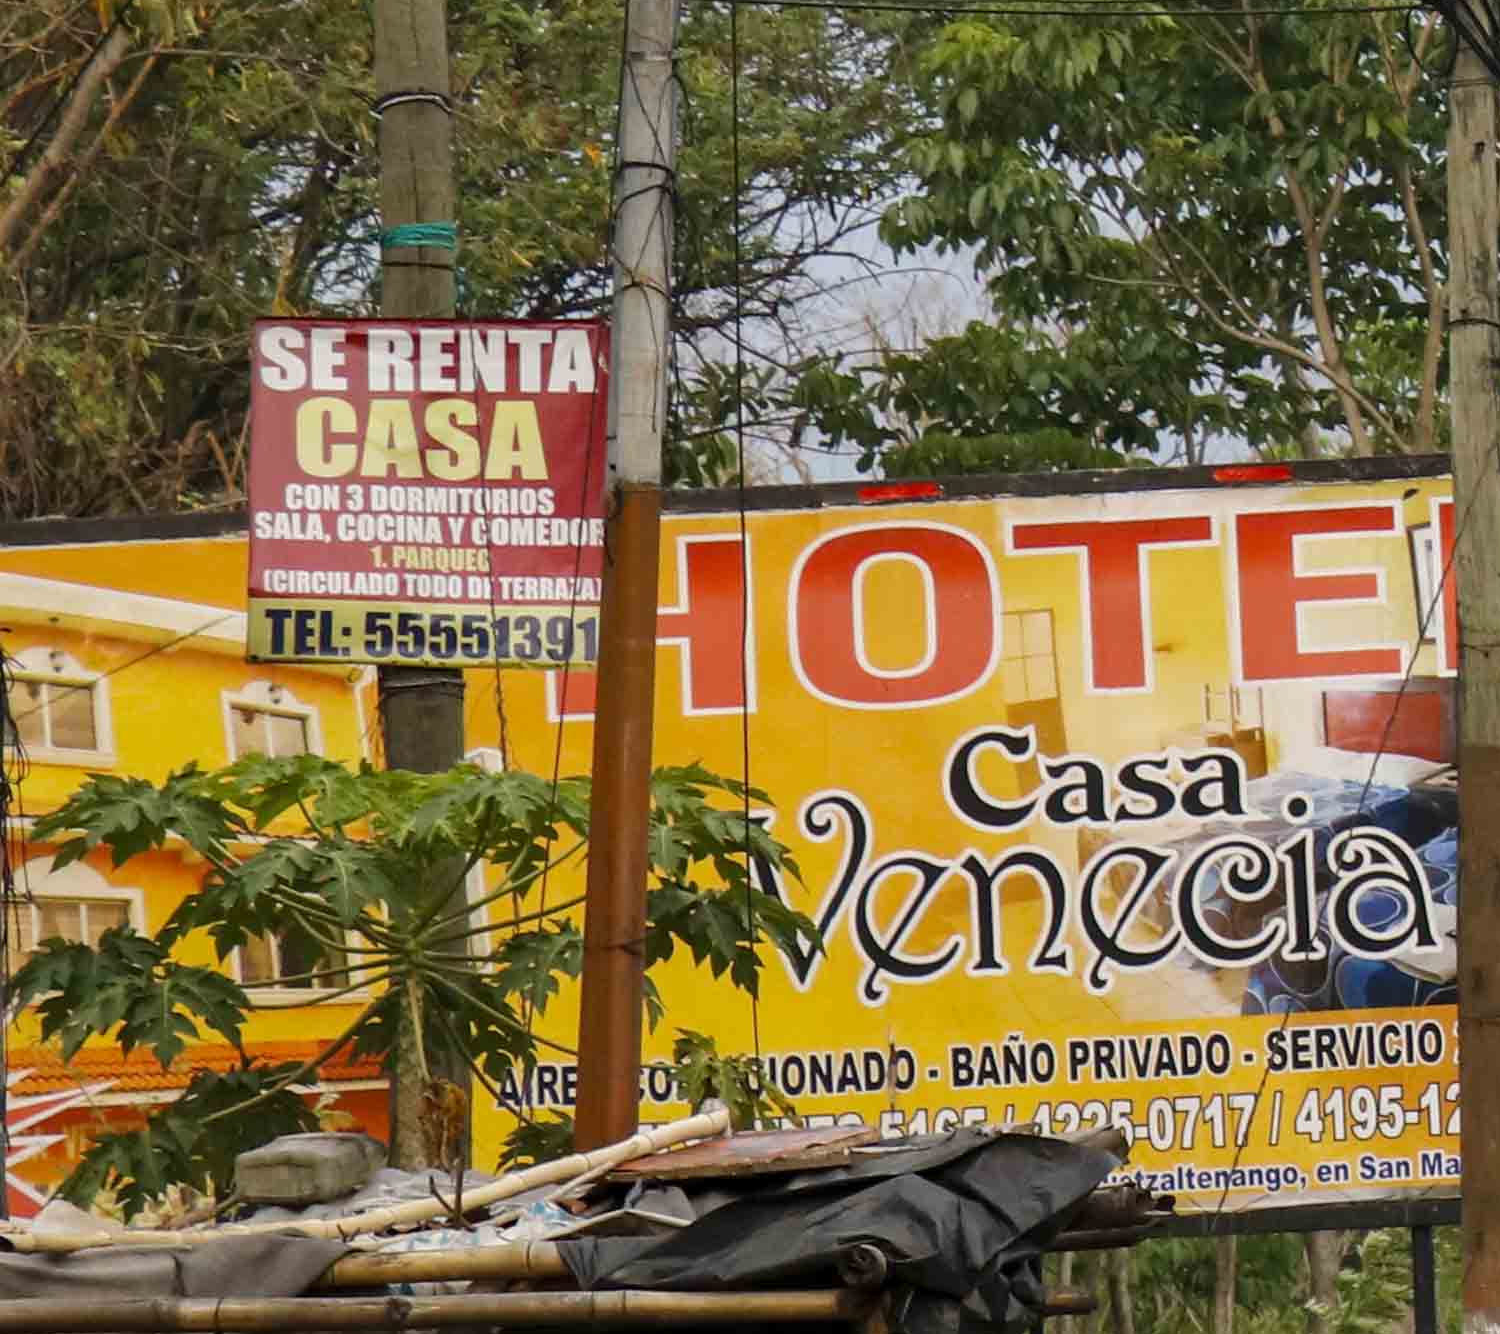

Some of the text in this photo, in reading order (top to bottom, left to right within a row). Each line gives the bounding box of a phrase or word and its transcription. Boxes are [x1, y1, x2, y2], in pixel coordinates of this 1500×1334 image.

[259, 327, 597, 394] SE RENTA
[295, 397, 549, 482] CASA
[255, 513, 604, 547] SALA, COCINA Y COMEDOR
[285, 484, 555, 516] CON 3 DORMITORIOS
[263, 570, 398, 596] (CIRCULADO
[404, 573, 462, 599] TODO
[265, 609, 597, 662] TEL: 55551391
[946, 727, 1250, 830] Casa
[738, 795, 1439, 1001] Venecia
[951, 1035, 1054, 1088] BAÑO
[1069, 1033, 1230, 1081] PRIVADO
[1266, 1021, 1443, 1071] SERVICIO
[1317, 1161, 1349, 1181] en
[1360, 1154, 1411, 1179] San
